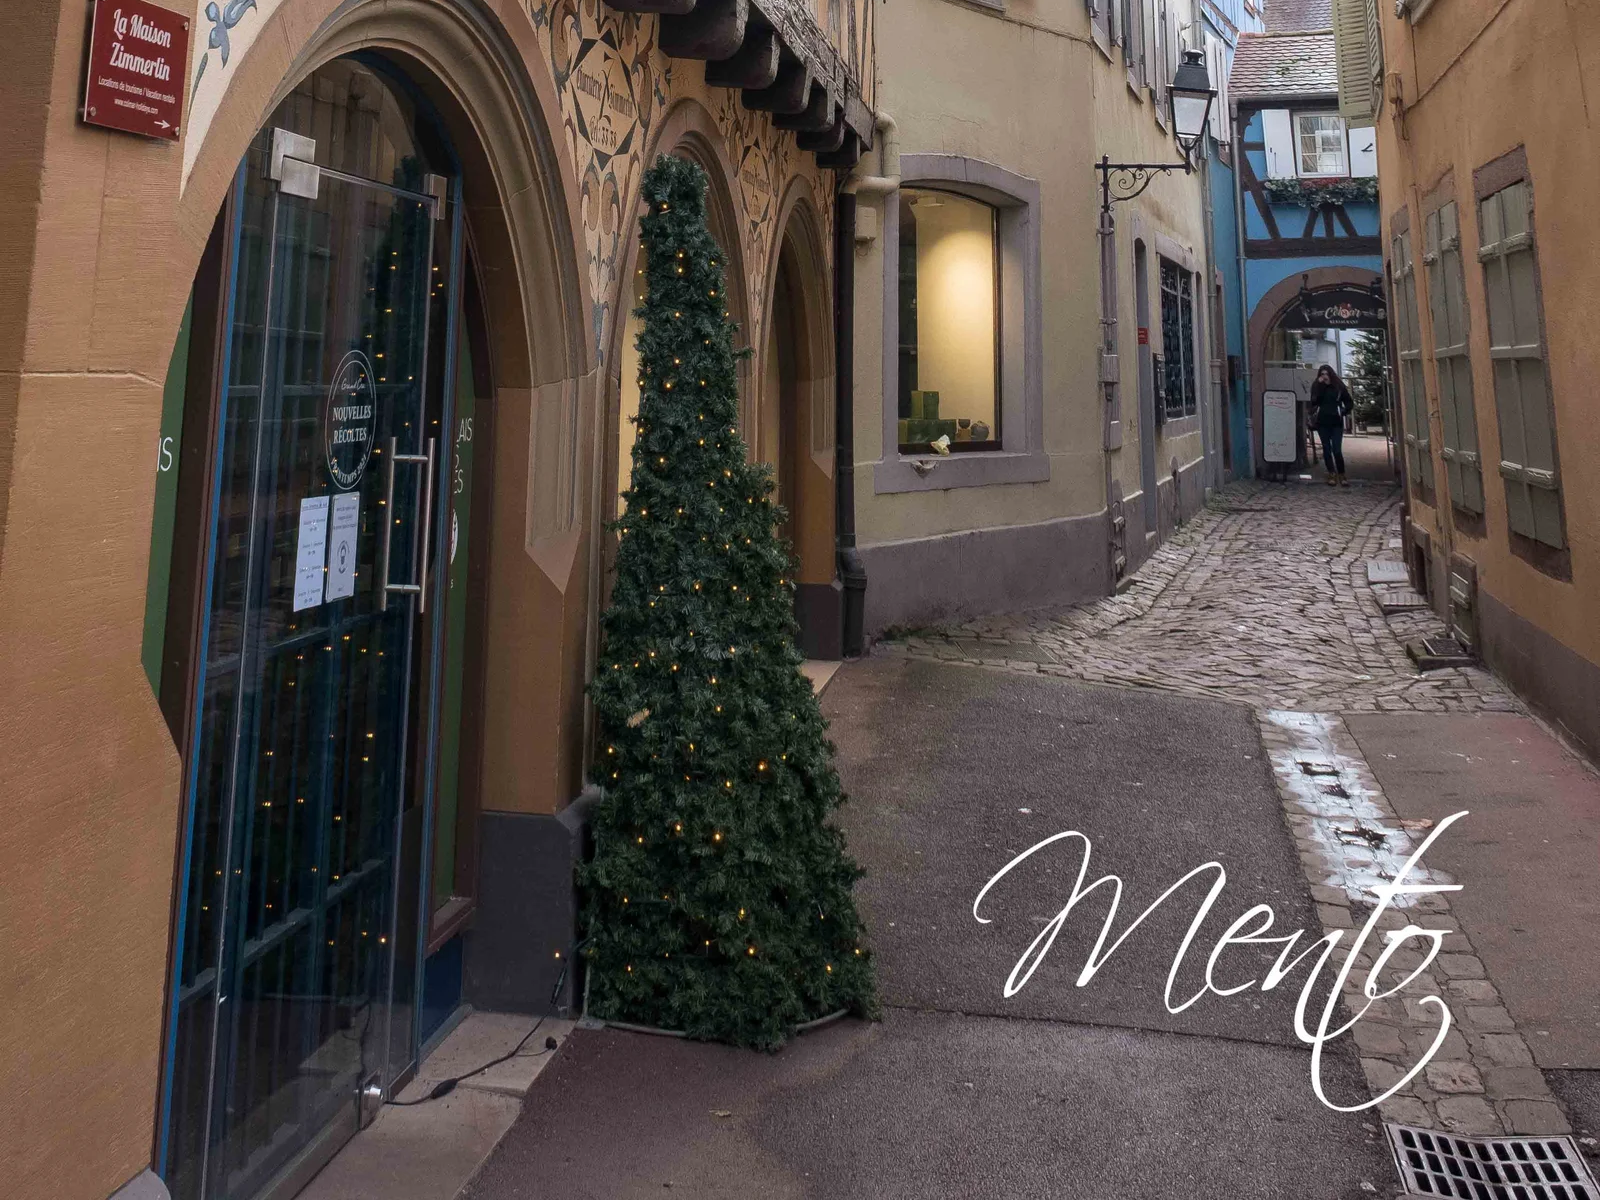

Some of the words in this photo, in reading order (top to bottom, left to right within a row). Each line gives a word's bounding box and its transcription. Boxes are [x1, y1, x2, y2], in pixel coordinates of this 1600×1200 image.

[113, 9, 128, 40] La
[129, 14, 171, 48] Maison
[109, 42, 171, 81] Zimmerlin
[98, 75, 119, 90] Locations
[119, 81, 125, 91] de
[125, 82, 143, 95] tourisme
[333, 405, 371, 421] NOUVELLES
[333, 427, 367, 444] RÉCOLTES
